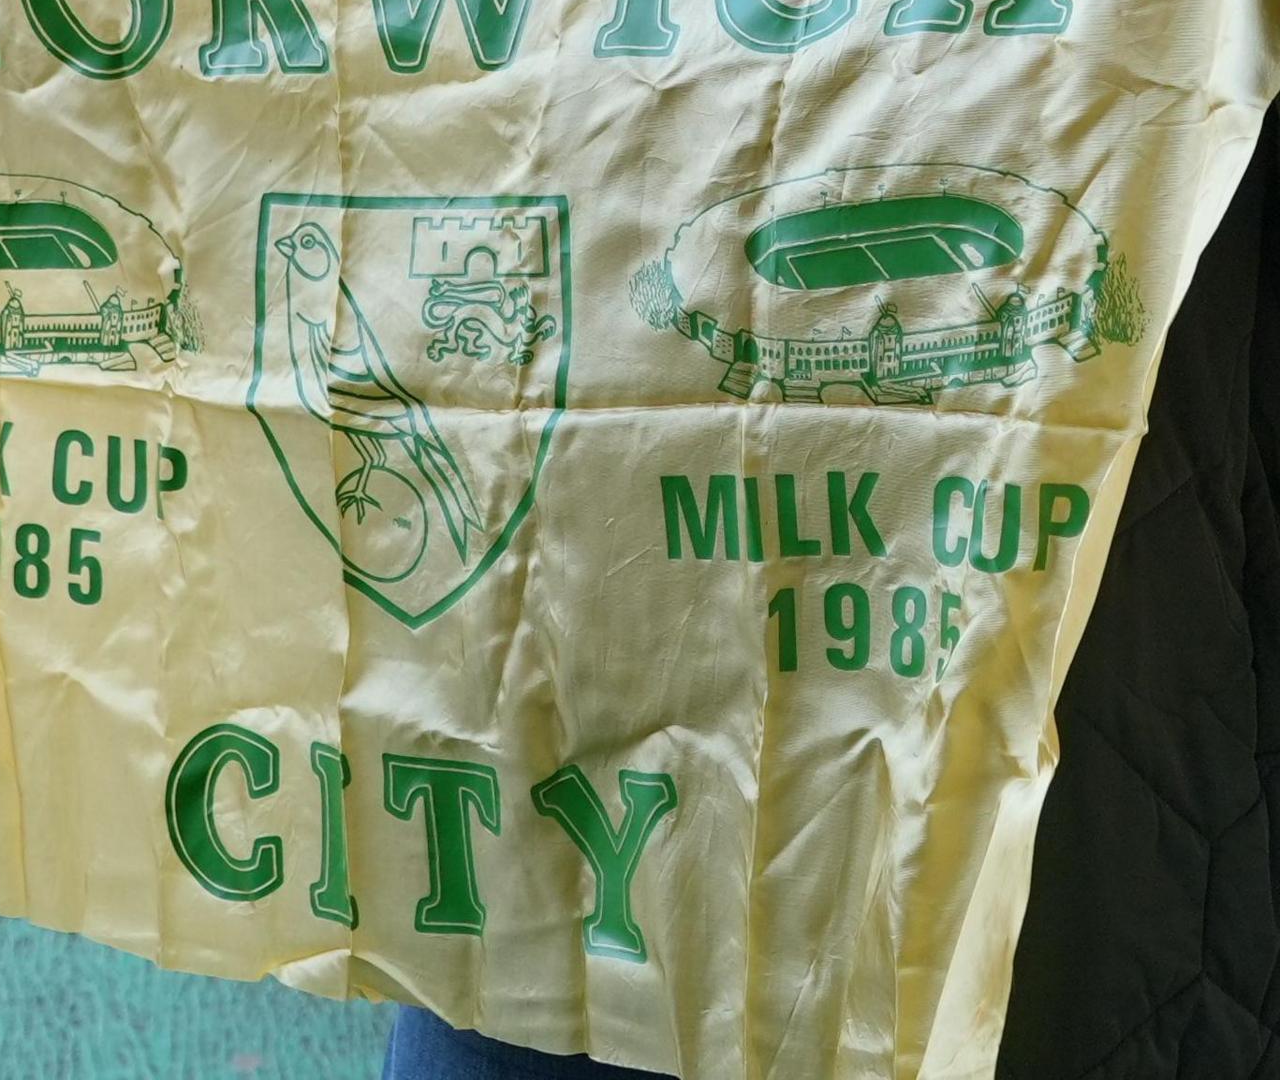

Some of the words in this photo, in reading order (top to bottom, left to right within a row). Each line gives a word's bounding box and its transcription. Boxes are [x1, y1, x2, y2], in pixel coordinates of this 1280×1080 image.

[52, 429, 189, 520] CUP
[660, 471, 887, 562] MILK
[932, 476, 1091, 573] CUP
[165, 723, 678, 964] CITY
